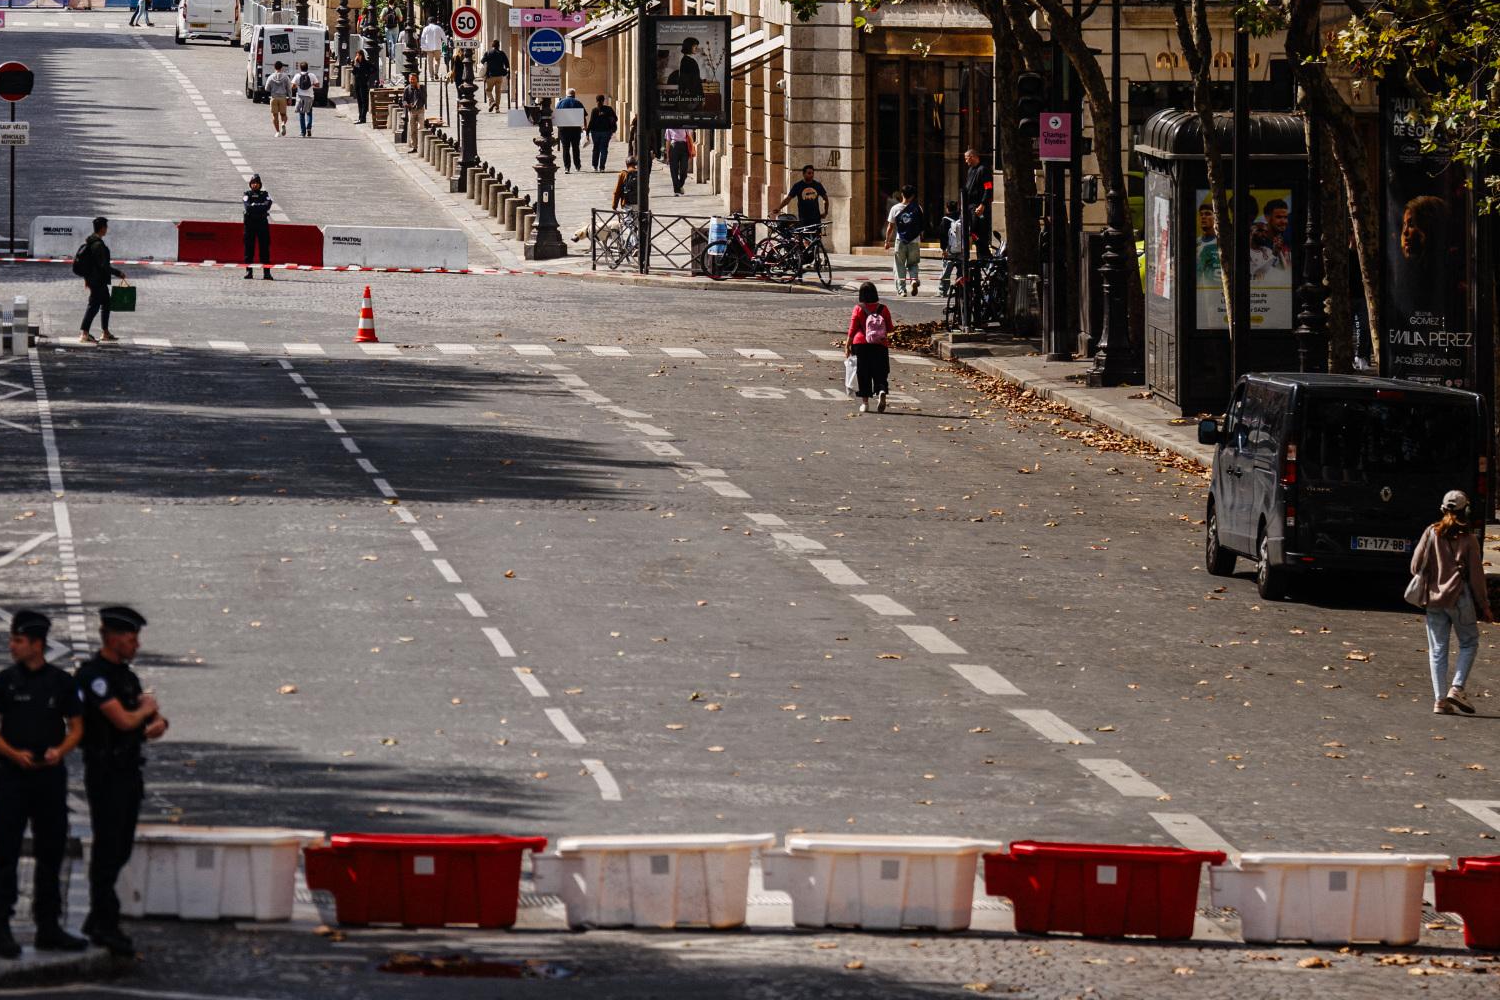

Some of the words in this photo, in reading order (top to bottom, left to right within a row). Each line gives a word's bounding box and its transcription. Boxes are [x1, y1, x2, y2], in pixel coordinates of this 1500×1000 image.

[457, 16, 476, 30] 50
[1042, 131, 1069, 139] Champs-
[1409, 316, 1440, 326] GOMEZ
[1389, 328, 1427, 347] EMILIA
[1424, 357, 1462, 367] AUDIARD
[735, 386, 922, 404] BUS
